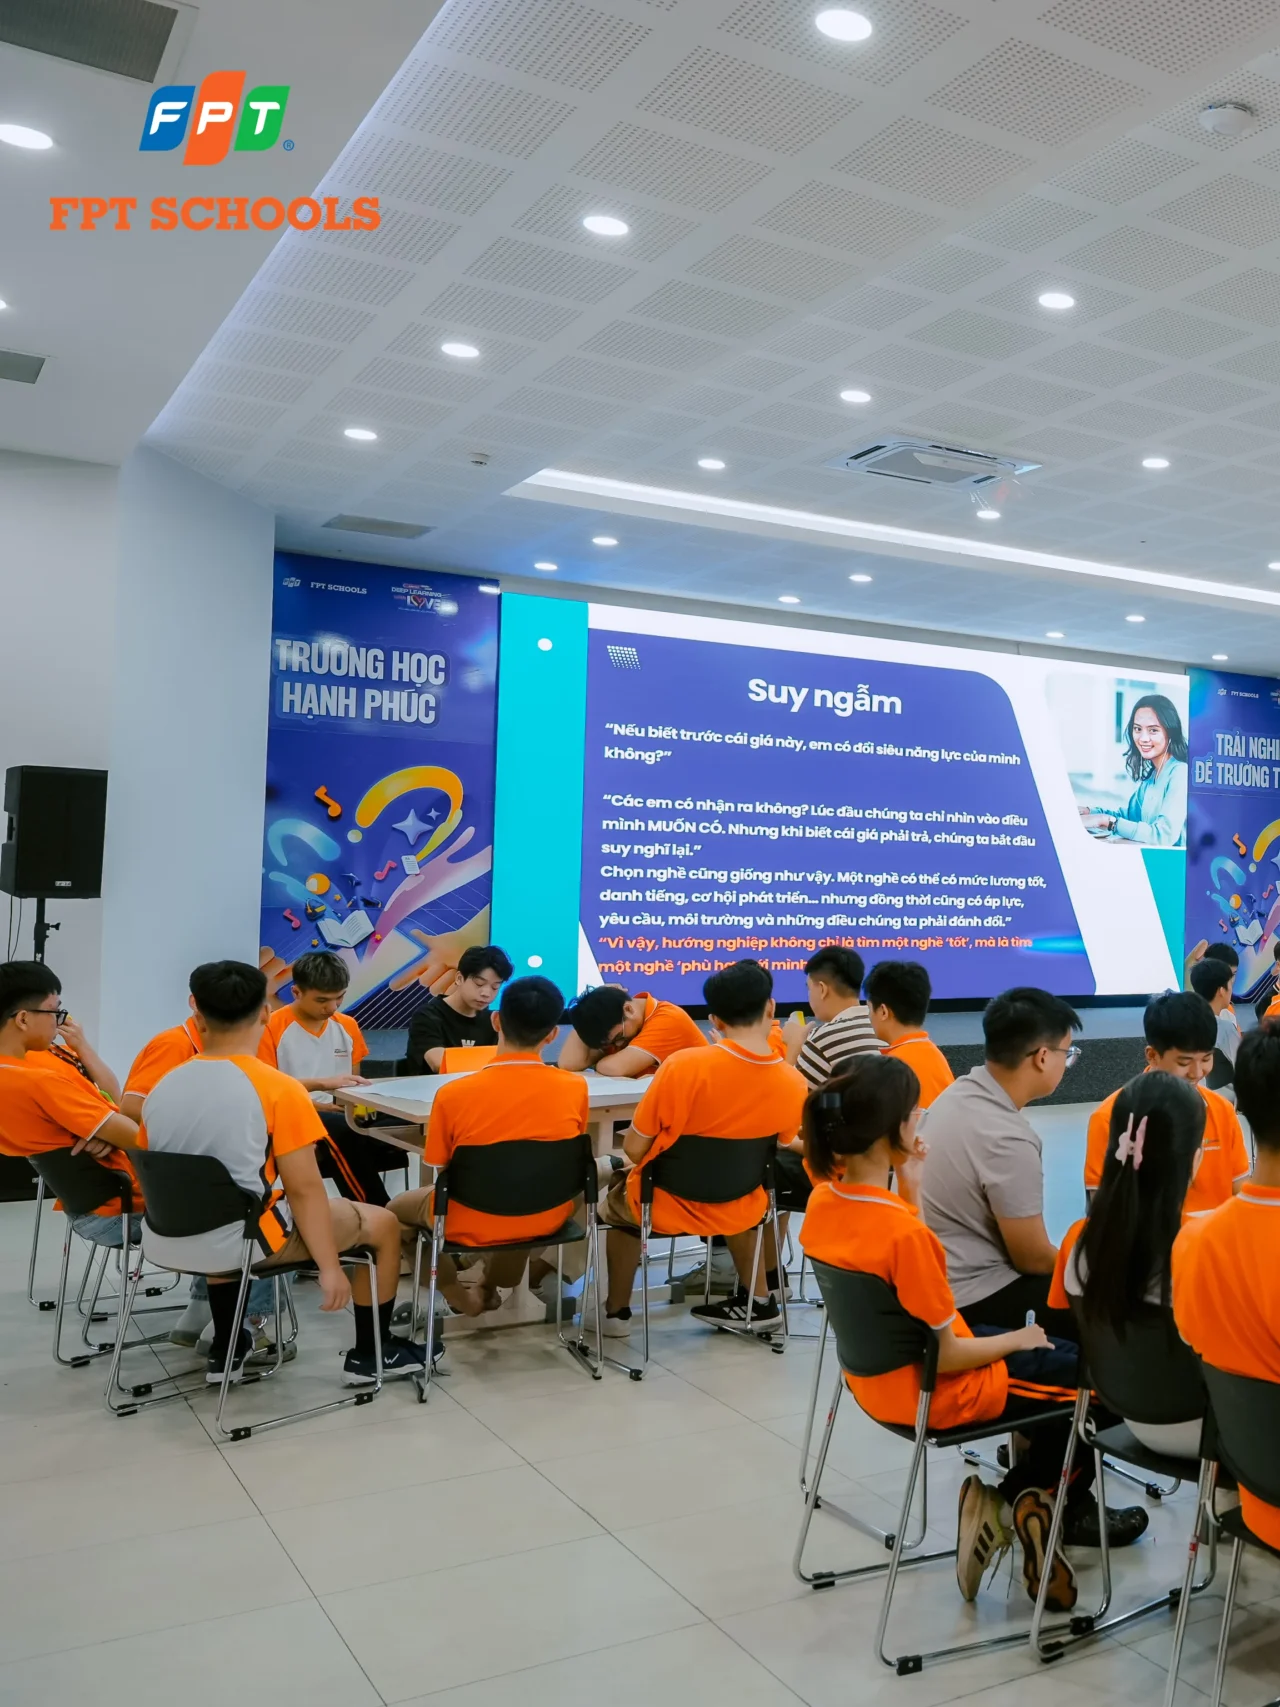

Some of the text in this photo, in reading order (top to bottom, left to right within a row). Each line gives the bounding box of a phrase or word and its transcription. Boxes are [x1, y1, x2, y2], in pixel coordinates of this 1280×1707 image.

[310, 581, 367, 594] FPT SCHOOLS
[392, 650, 446, 687] HỌC
[282, 681, 436, 725] HẠNH PHÚC
[748, 678, 901, 717] Suy ngẫm
[648, 726, 678, 740] biết
[680, 729, 723, 743] trước
[724, 732, 748, 745] cái
[750, 733, 773, 749] giá
[776, 736, 807, 752] này,
[809, 741, 832, 751] em
[834, 740, 851, 752] có
[853, 741, 874, 754] đổi
[876, 743, 903, 756] siêu
[905, 746, 939, 762] năng
[941, 749, 961, 762] lực
[963, 750, 987, 762] của
[988, 752, 1021, 765] mình
[1216, 731, 1246, 758] TRẢI
[1216, 761, 1270, 788] TRƯỞNG
[646, 798, 673, 809] em
[674, 797, 694, 810] có
[696, 799, 735, 814] nhận
[737, 803, 753, 813] ra
[755, 801, 809, 818] không?
[811, 804, 835, 816] Lúc
[836, 805, 863, 818] đầu
[864, 807, 907, 824] chúng
[909, 810, 923, 821] ta
[924, 810, 945, 822] chỉ
[946, 812, 975, 824] nhìn
[976, 813, 1000, 825] vào
[1001, 814, 1028, 826] điều
[602, 817, 1036, 847] mình MUỐN CÓ. Nhưng khi biết cái giá phải trả, chúng ta bắt đầu
[601, 844, 631, 857] suy
[634, 843, 671, 858] nghĩ
[600, 866, 1047, 890] Chọn nghề cũng giống như vậy. Một nghề có thể có mức lương tốt,
[600, 889, 643, 901] danh
[645, 889, 689, 906] tiếng,
[691, 892, 712, 902] cơ
[713, 890, 737, 905] hội
[739, 891, 774, 906] phát
[821, 893, 867, 908] nhưng
[869, 893, 903, 908] đồng
[905, 894, 931, 905] thời
[932, 895, 965, 909] cũng
[967, 895, 983, 906] có
[984, 895, 1001, 909] áp
[1002, 896, 1024, 909] lực,
[599, 912, 630, 928] yêu
[632, 912, 665, 927] cầu,
[668, 913, 699, 925] môi
[700, 914, 753, 929] trường
[755, 913, 775, 926] và
[777, 914, 825, 929] những
[826, 914, 857, 926] điều
[858, 914, 901, 930] chúng
[903, 916, 917, 926] ta
[919, 915, 947, 930] phải
[948, 915, 982, 927] đánh
[626, 936, 659, 952] vậy,
[662, 936, 714, 952] hướng
[716, 936, 769, 952] nghiệp
[770, 936, 816, 951] không
[856, 936, 880, 948] tìm
[882, 936, 909, 950] một
[974, 936, 996, 947] mà
[997, 936, 1009, 947] là
[1010, 936, 1033, 948] tìm
[599, 960, 631, 975] một
[634, 959, 674, 975] nghề
